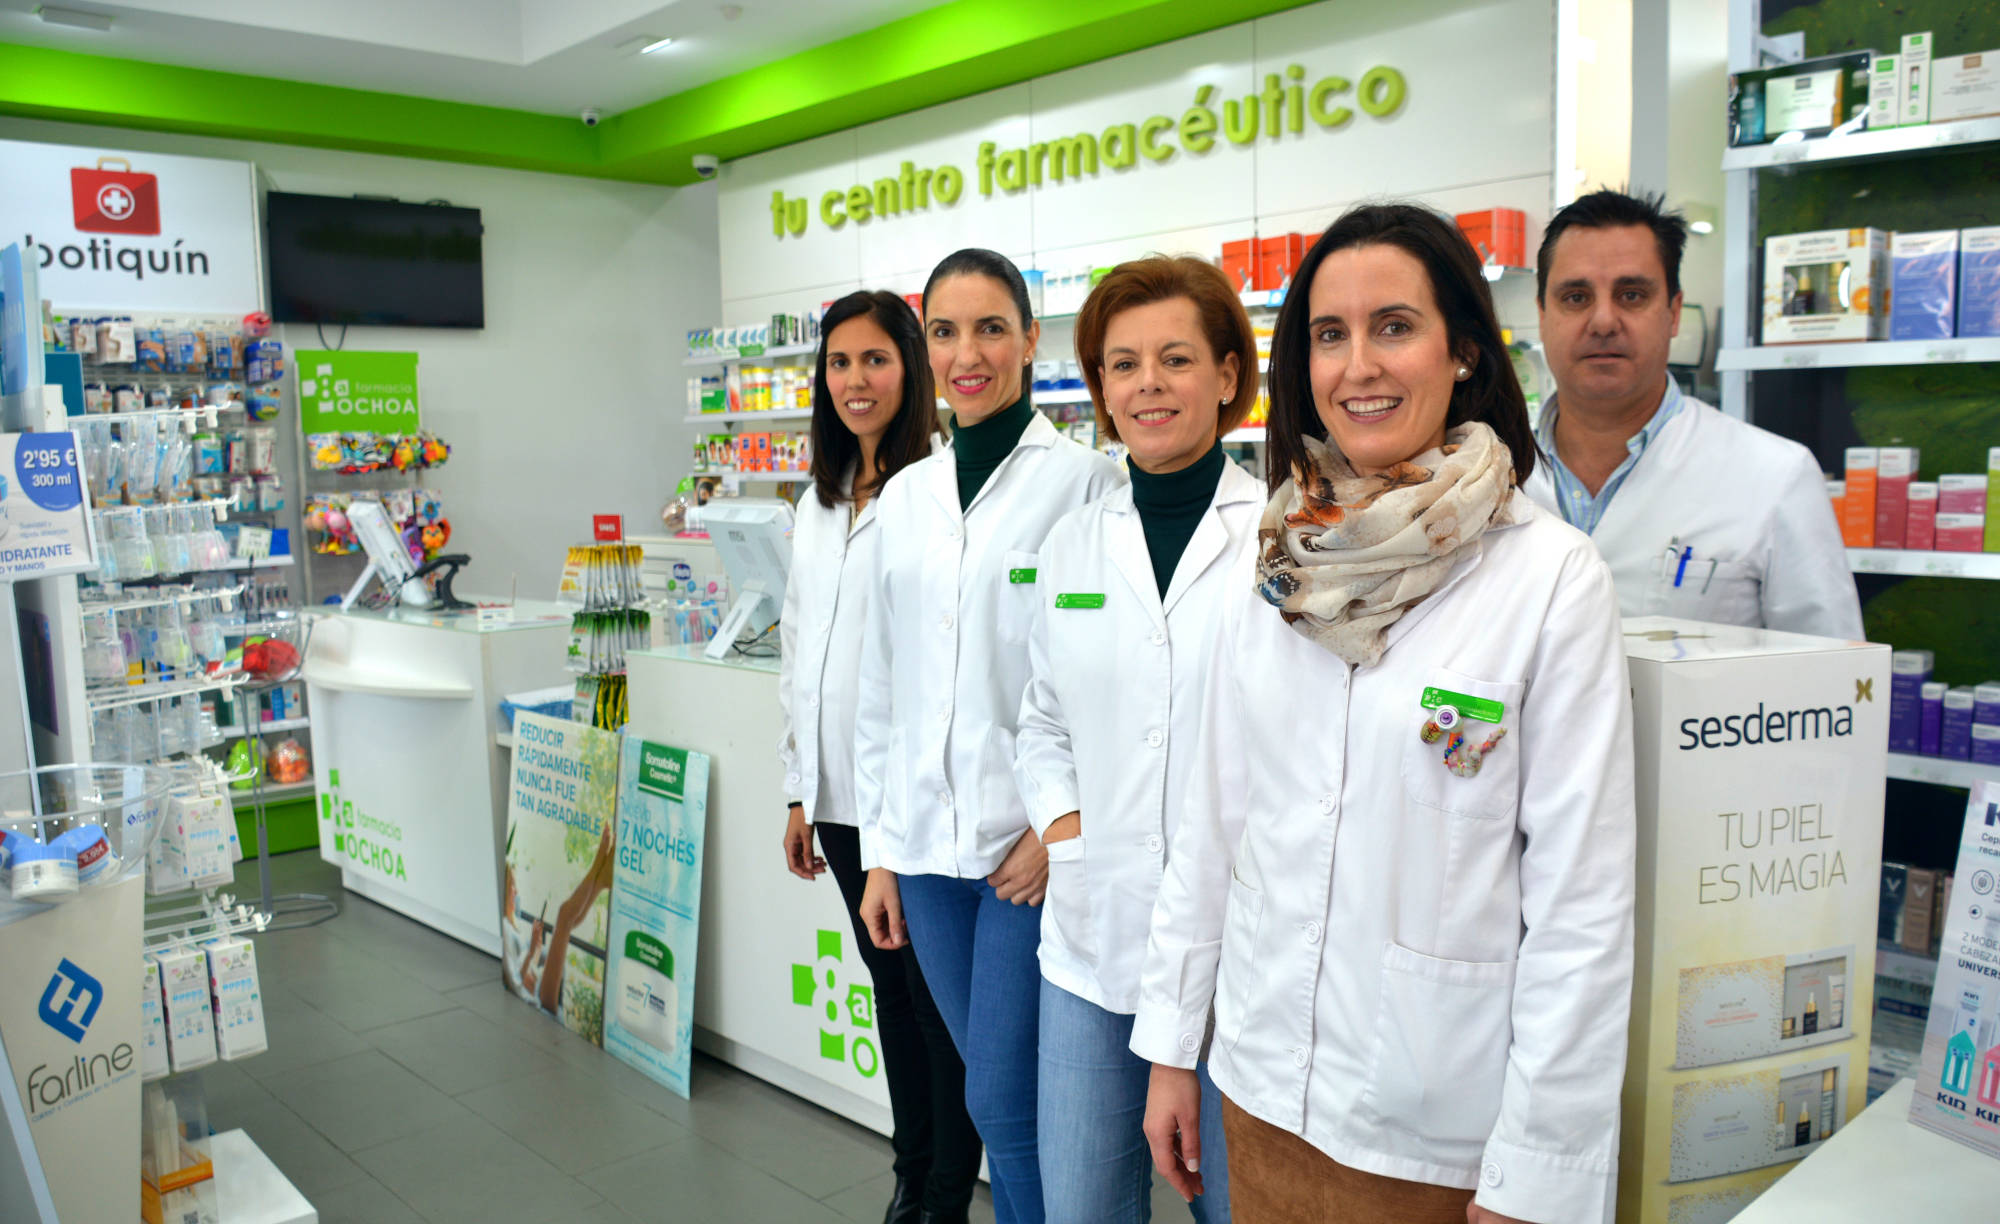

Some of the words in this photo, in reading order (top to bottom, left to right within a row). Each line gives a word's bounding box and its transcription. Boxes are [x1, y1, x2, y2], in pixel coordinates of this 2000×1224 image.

[770, 189, 808, 238] tu
[819, 160, 964, 227] centro
[976, 64, 1407, 196] farmacéutico
[337, 398, 416, 415] OCHOA
[355, 382, 413, 394] farmacia
[23, 448, 62, 469] 2'95
[65, 448, 77, 467] €
[32, 474, 55, 487] 300
[57, 473, 72, 486] ml
[14, 561, 46, 572] MANOS
[520, 722, 564, 749] REDUCIR
[1679, 702, 1853, 750] sesderma
[518, 742, 592, 783] RÁPIDAMENTE
[516, 768, 552, 795] NUNCA
[555, 779, 576, 802] FUE
[516, 789, 535, 811] TAN
[536, 798, 602, 837] AGRADABLE
[1718, 810, 1762, 851] TU
[1770, 803, 1833, 846] PIEL
[346, 833, 408, 882] OCHOA
[619, 846, 646, 875] GEL
[621, 819, 629, 841] 7
[632, 823, 696, 867] NOCHES
[1698, 864, 1741, 905] ES
[1749, 850, 1847, 899] MAGIA
[1962, 932, 1969, 941] 2
[27, 1043, 133, 1113] farline
